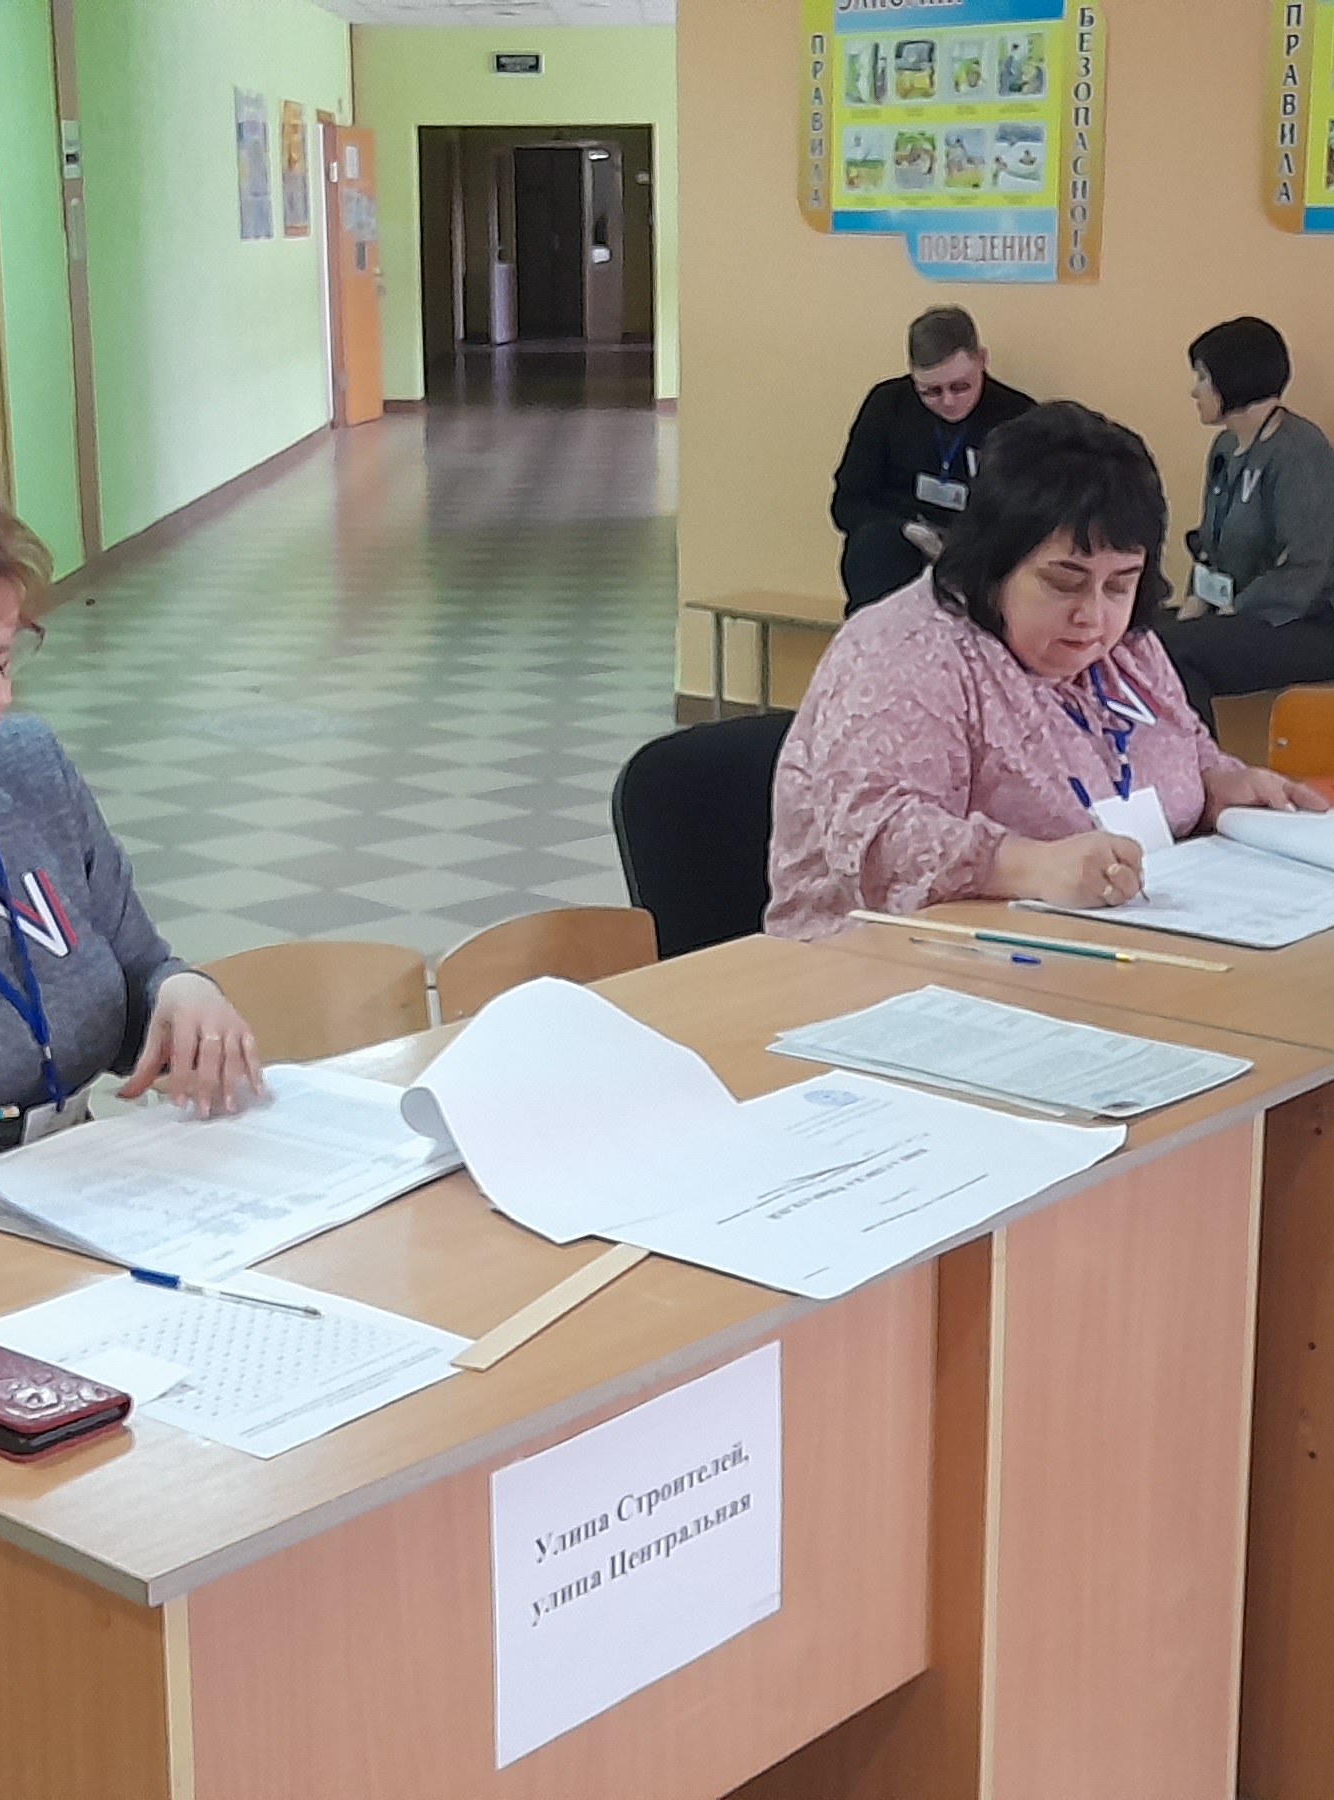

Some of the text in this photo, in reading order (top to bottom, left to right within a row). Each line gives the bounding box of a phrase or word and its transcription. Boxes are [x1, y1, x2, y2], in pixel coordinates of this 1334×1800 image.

[809, 34, 826, 207] ПРАВИЛА
[1067, 7, 1095, 273] БЕЗОПАСНОГО
[1275, 3, 1304, 204] ПРАВИЛА
[919, 234, 1047, 263] ПОВЕДЕНИЯ
[531, 1493, 752, 1627] улица Центральная
[534, 1512, 610, 1564] Улица
